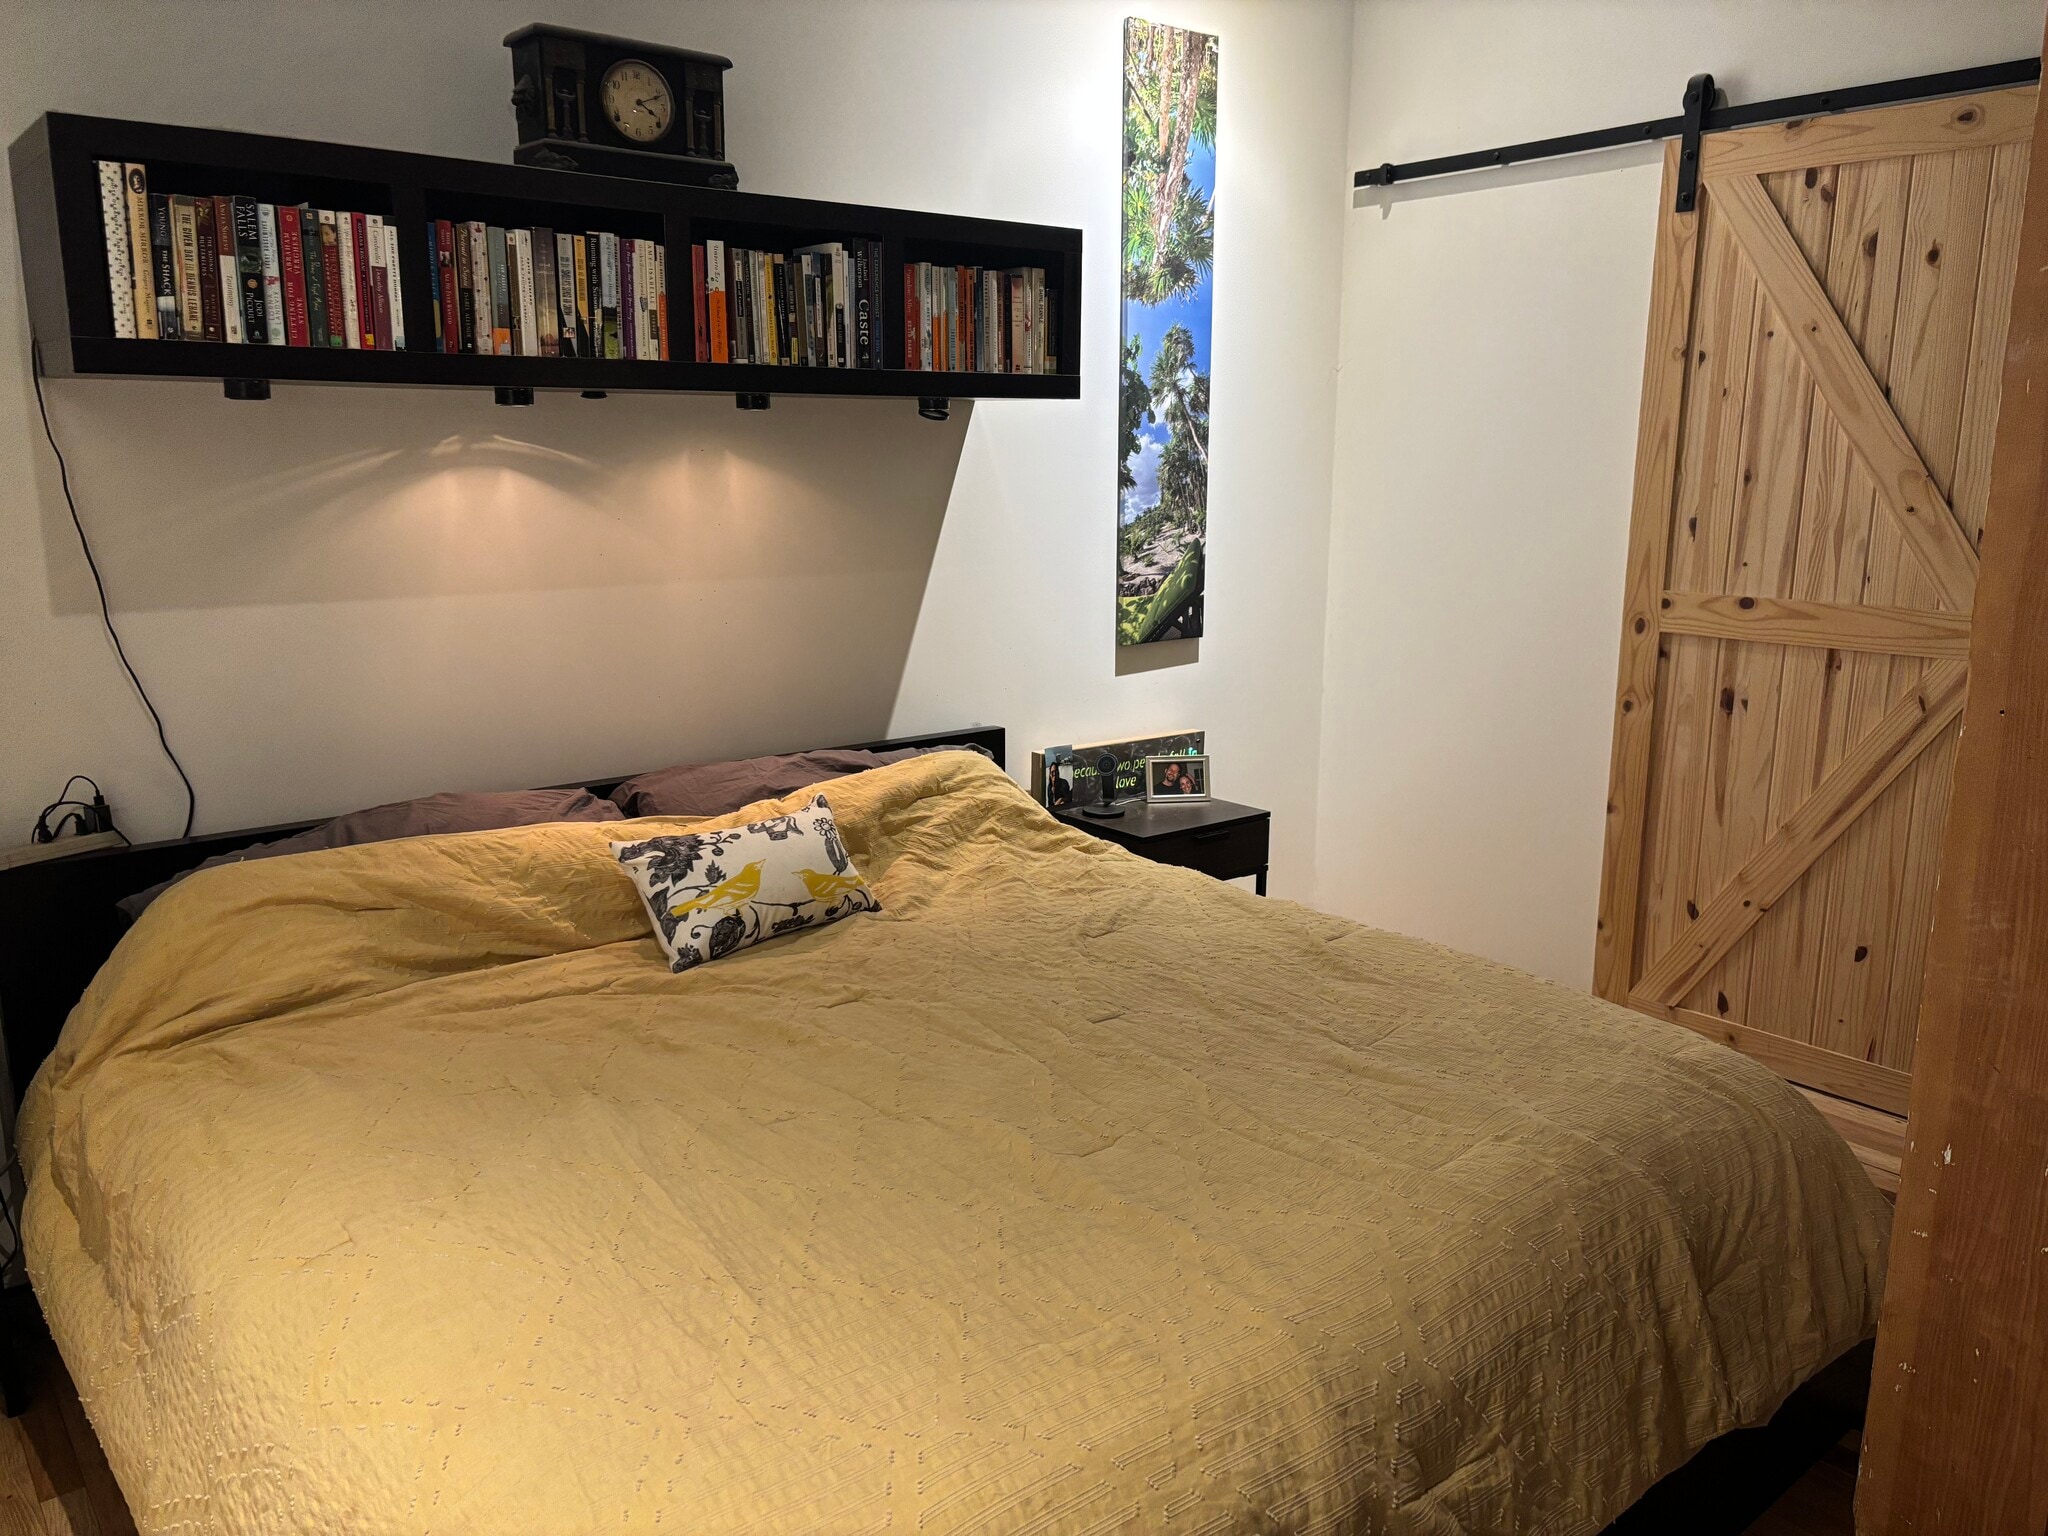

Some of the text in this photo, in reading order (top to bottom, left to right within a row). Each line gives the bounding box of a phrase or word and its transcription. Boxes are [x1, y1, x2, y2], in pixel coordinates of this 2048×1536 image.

[158, 206, 166, 237] YOUNG
[234, 204, 248, 237] FALLS
[244, 202, 256, 240] SALEM
[284, 231, 293, 272] ABRAHAM
[289, 230, 300, 274] VERGHESE
[459, 228, 468, 256] Portrait
[162, 263, 171, 295] SHACK
[181, 213, 198, 322] THE GIVEN DAY DENNIS LEHANE
[373, 268, 383, 292] Dorothy
[224, 274, 234, 307] Testimony
[244, 291, 257, 324] PICOULT
[254, 298, 263, 317] JODI
[288, 300, 298, 338] CUTTING
[859, 298, 869, 345] Caste
[1116, 776, 1136, 789] love
